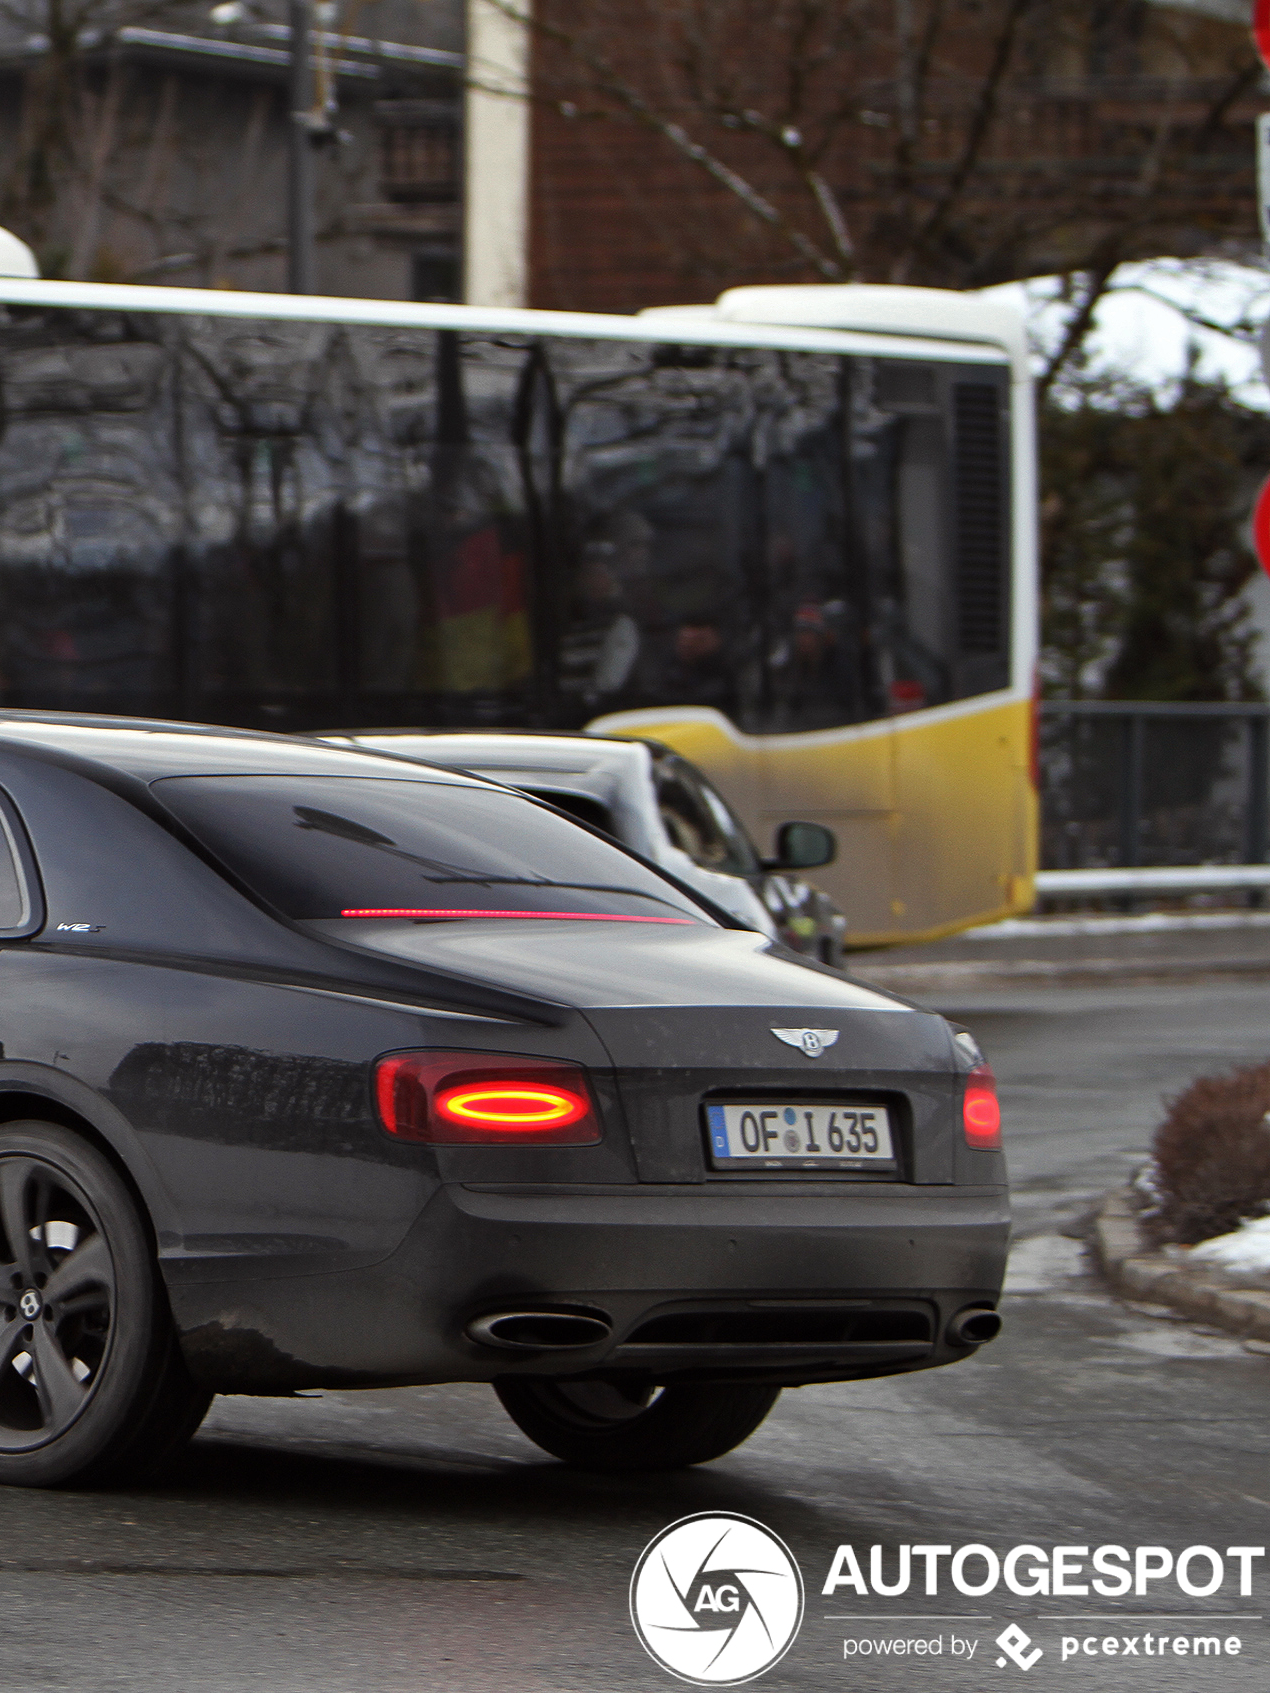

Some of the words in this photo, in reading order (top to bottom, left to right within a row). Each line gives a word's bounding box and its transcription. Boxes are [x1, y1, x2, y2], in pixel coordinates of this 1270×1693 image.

[740, 1110, 778, 1153] OF
[803, 1111, 820, 1152] I
[827, 1111, 878, 1153] 635
